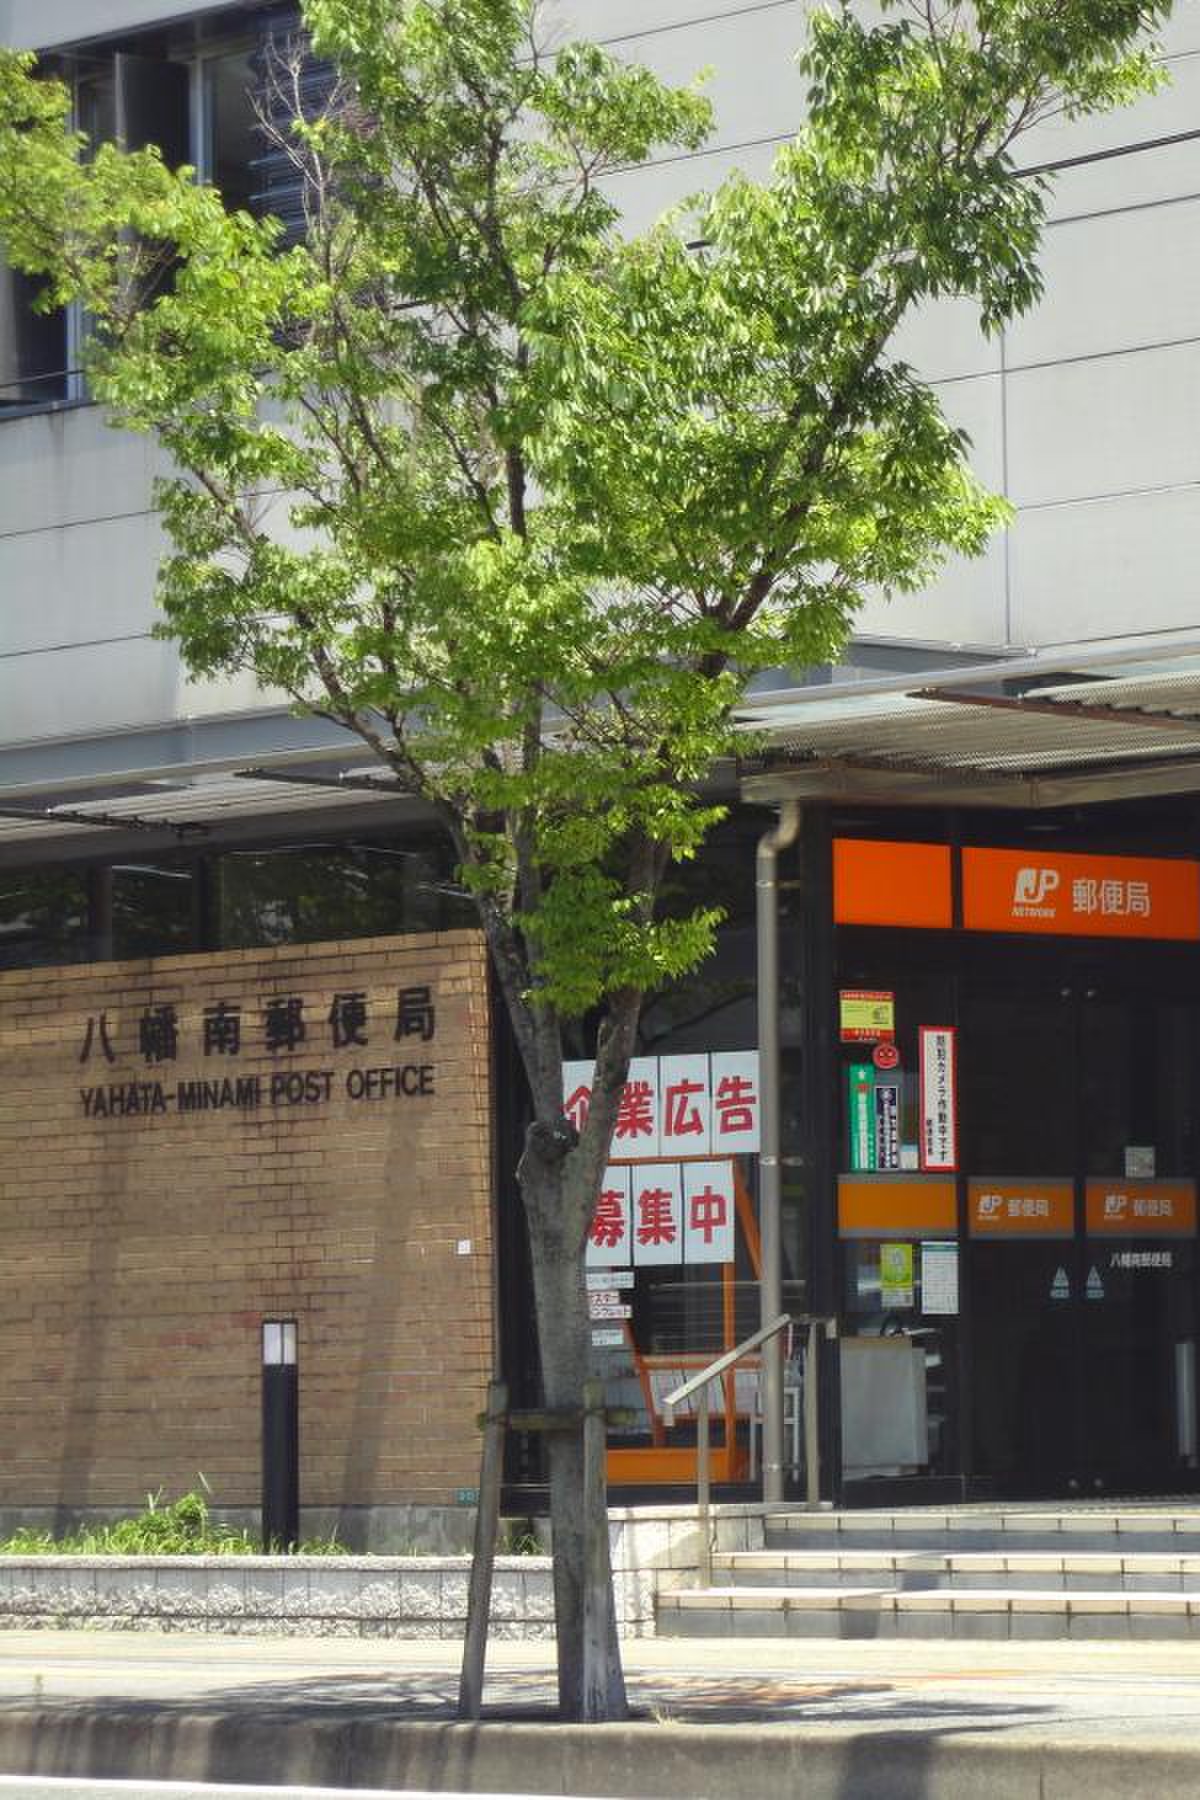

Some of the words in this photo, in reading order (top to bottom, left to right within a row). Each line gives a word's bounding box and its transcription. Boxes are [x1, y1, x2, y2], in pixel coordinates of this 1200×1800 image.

[1071, 876, 1152, 918] 郵便局
[79, 985, 436, 1065] 八幡南郵便局
[79, 1075, 260, 1118] YAHATA-MINAMI
[270, 1070, 335, 1105] POST
[346, 1065, 435, 1100] OFFICE
[587, 1185, 728, 1248] 募集中
[1007, 1199, 1049, 1217] 郵便局
